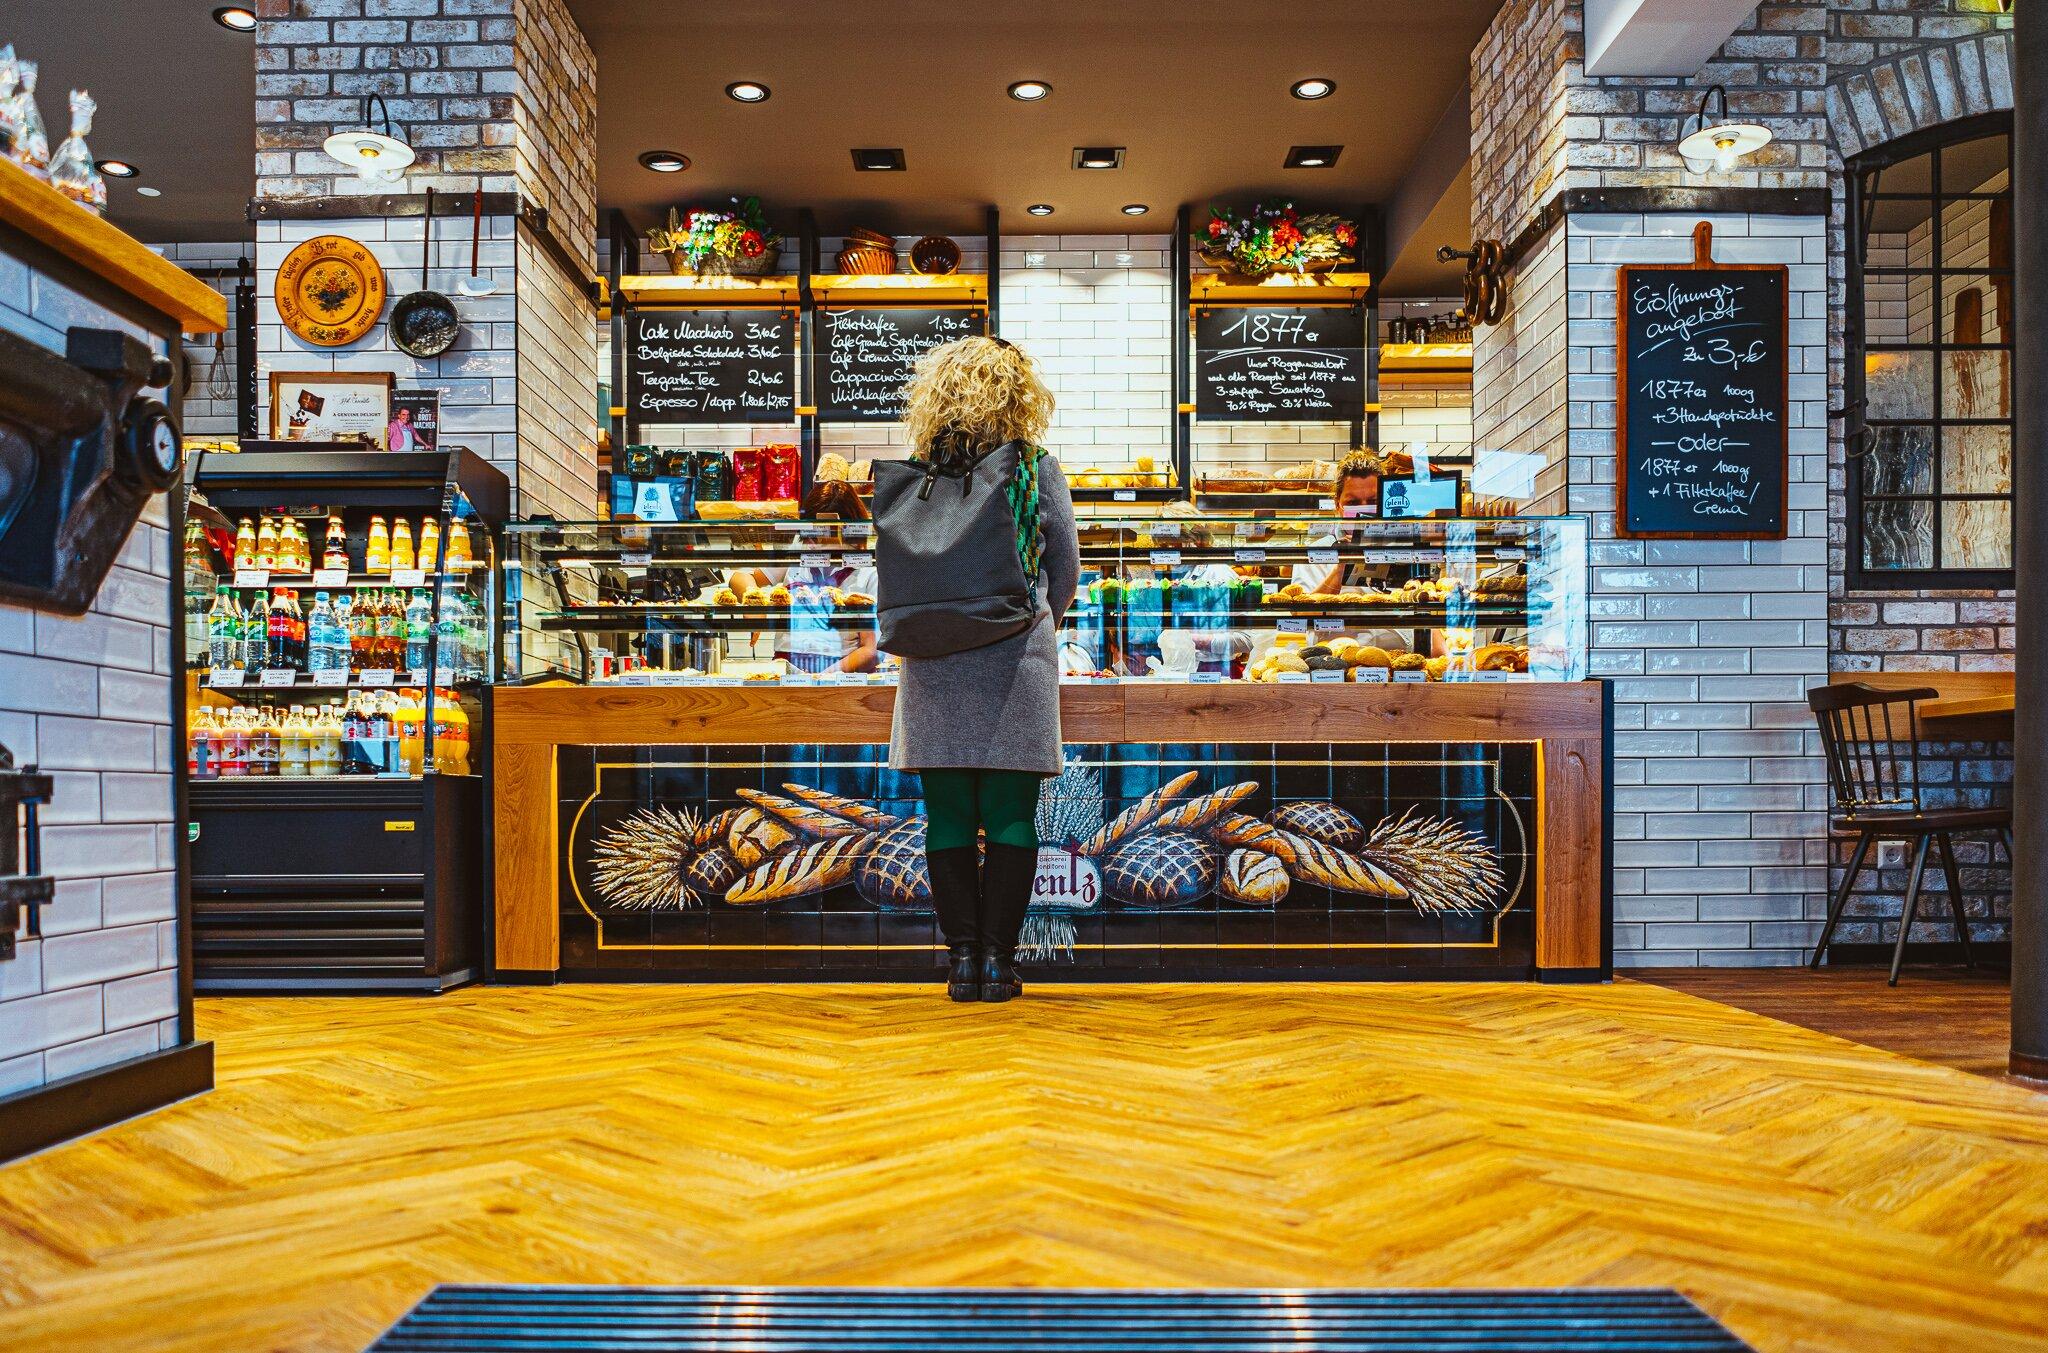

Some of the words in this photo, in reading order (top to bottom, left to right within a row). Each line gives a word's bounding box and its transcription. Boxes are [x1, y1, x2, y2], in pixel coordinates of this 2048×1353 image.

[1646, 298, 1744, 341] angebot
[639, 392, 698, 413] Espresso
[1693, 500, 1749, 516] Crema
[1033, 842, 1096, 903] entz
